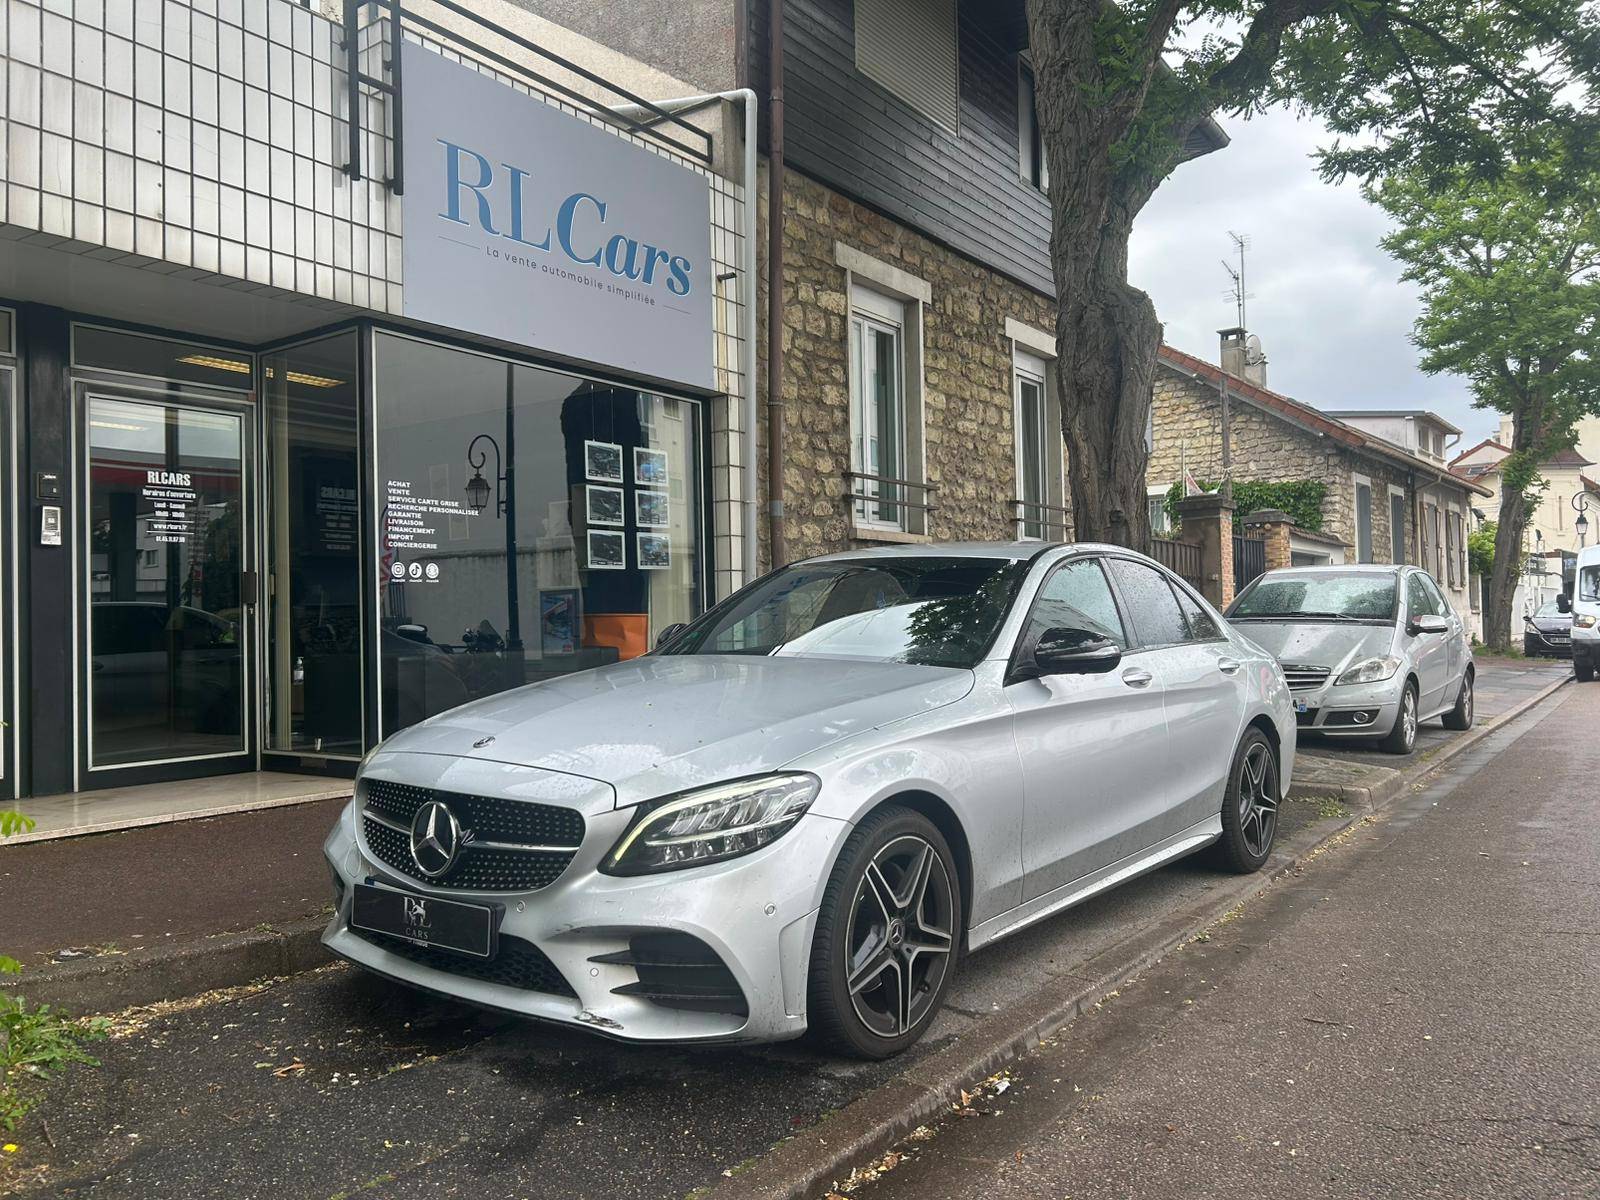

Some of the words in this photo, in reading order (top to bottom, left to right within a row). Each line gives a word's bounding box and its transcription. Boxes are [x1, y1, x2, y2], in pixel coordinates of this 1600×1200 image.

[486, 245, 499, 258] La
[504, 252, 537, 269] vente
[541, 263, 603, 290] automobile
[606, 284, 656, 306] simplifiée
[147, 470, 191, 486] RLCARS
[387, 480, 411, 488] ACHAT
[387, 496, 416, 504] SERVICE
[387, 503, 428, 512] RECHERCHE
[387, 511, 422, 519] GARANTIE
[387, 518, 424, 526] LIVRAISON
[387, 526, 435, 534] FINANCEMENT
[387, 533, 414, 541] IMPORT
[388, 541, 437, 549] CONCIERGERIE
